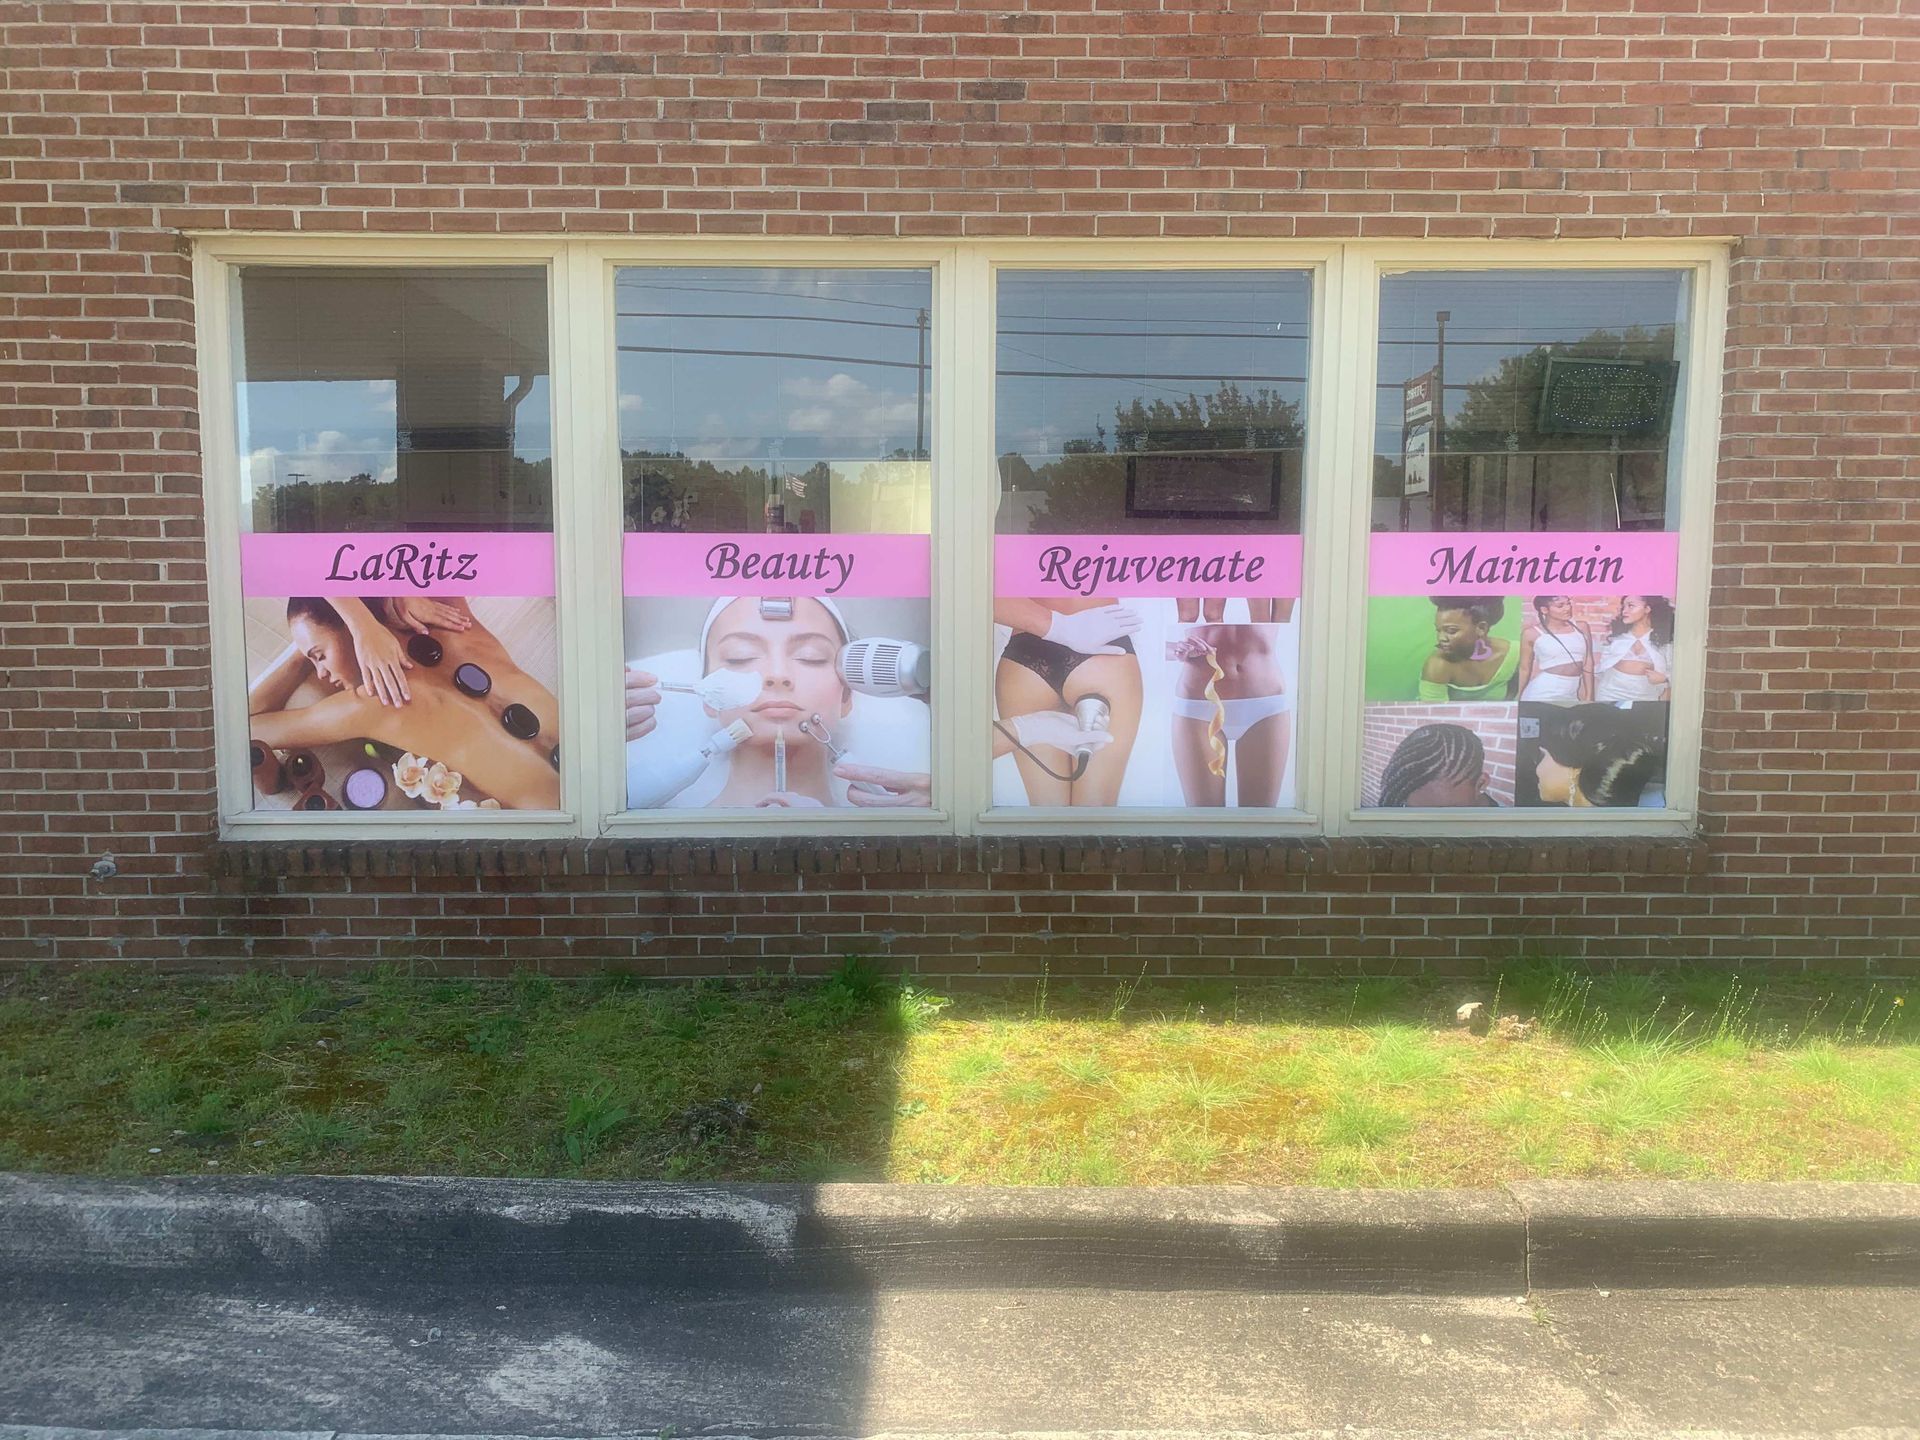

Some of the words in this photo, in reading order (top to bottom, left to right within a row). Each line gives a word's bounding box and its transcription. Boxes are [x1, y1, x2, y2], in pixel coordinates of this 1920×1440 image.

[1552, 380, 1661, 415] OPEN
[325, 541, 478, 589] LaRitz
[705, 542, 855, 594] Beauty
[1038, 544, 1265, 597] Rejuvenate
[1426, 544, 1624, 585] Maintain
